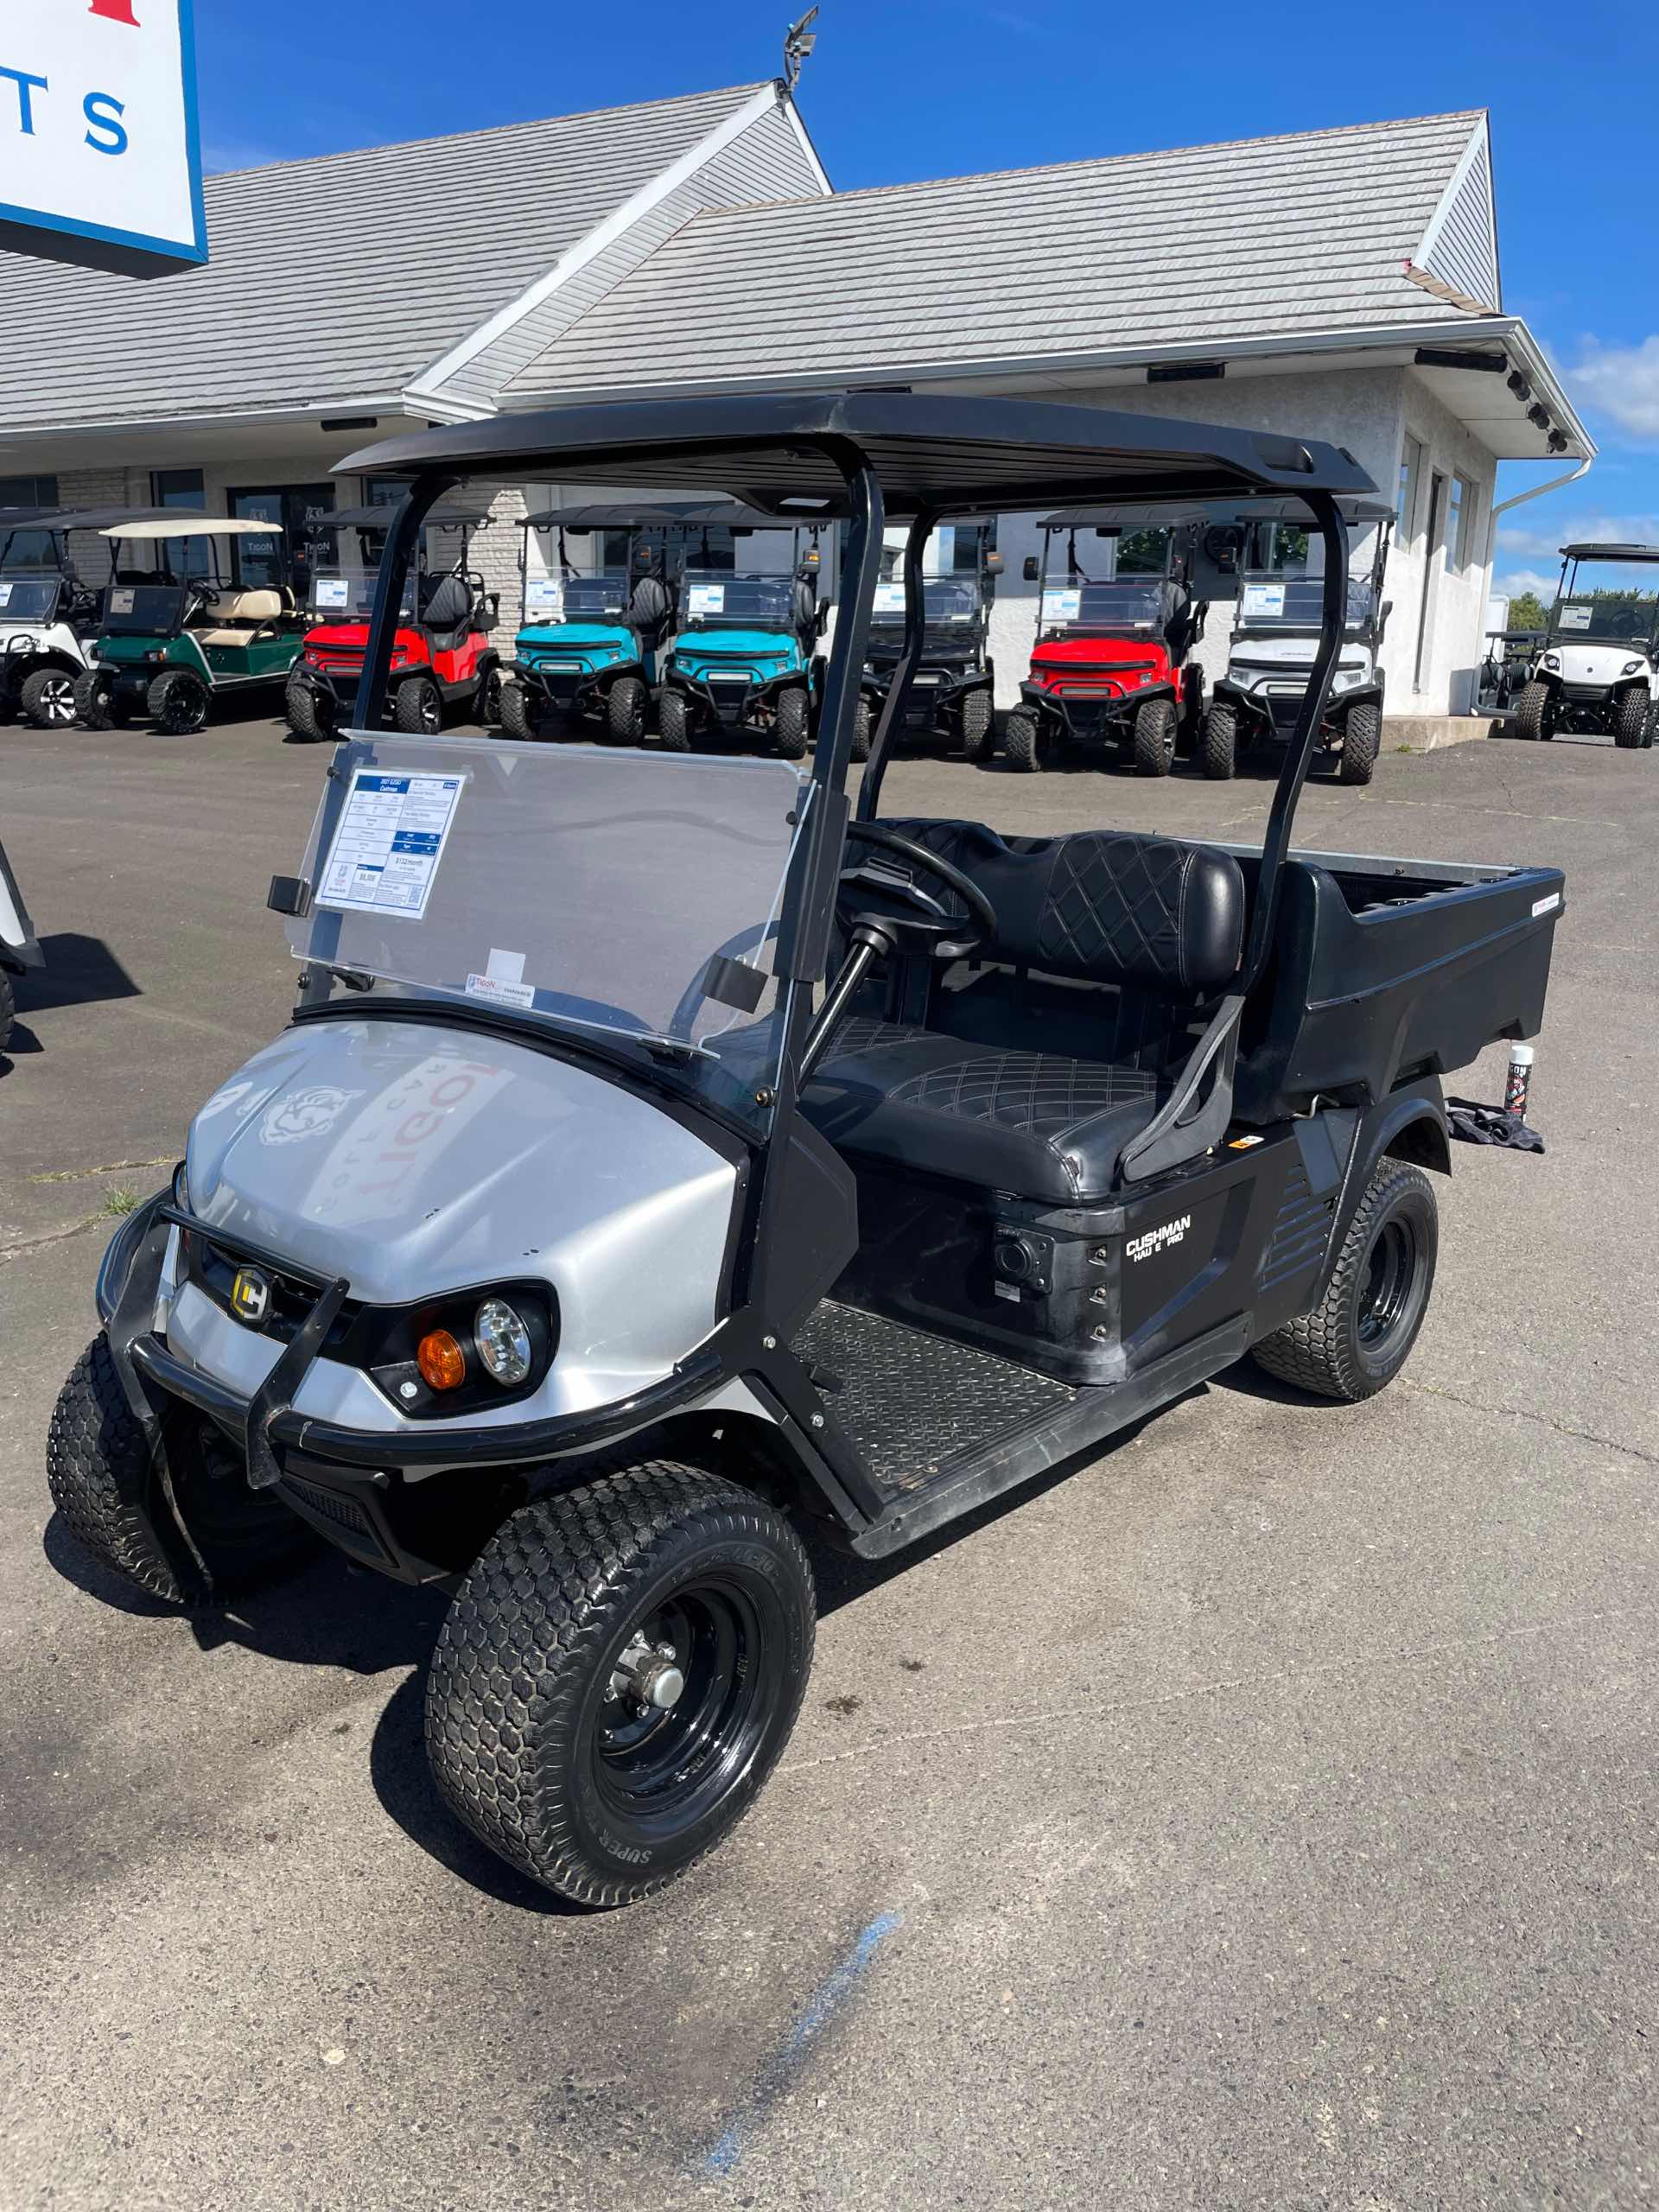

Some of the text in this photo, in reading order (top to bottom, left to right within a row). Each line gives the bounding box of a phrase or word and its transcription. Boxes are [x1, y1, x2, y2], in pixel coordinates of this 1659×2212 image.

[1126, 1214, 1191, 1256] CUSHMAN
[1166, 1231, 1184, 1247] PRO
[598, 1826, 654, 1866] SUPER
